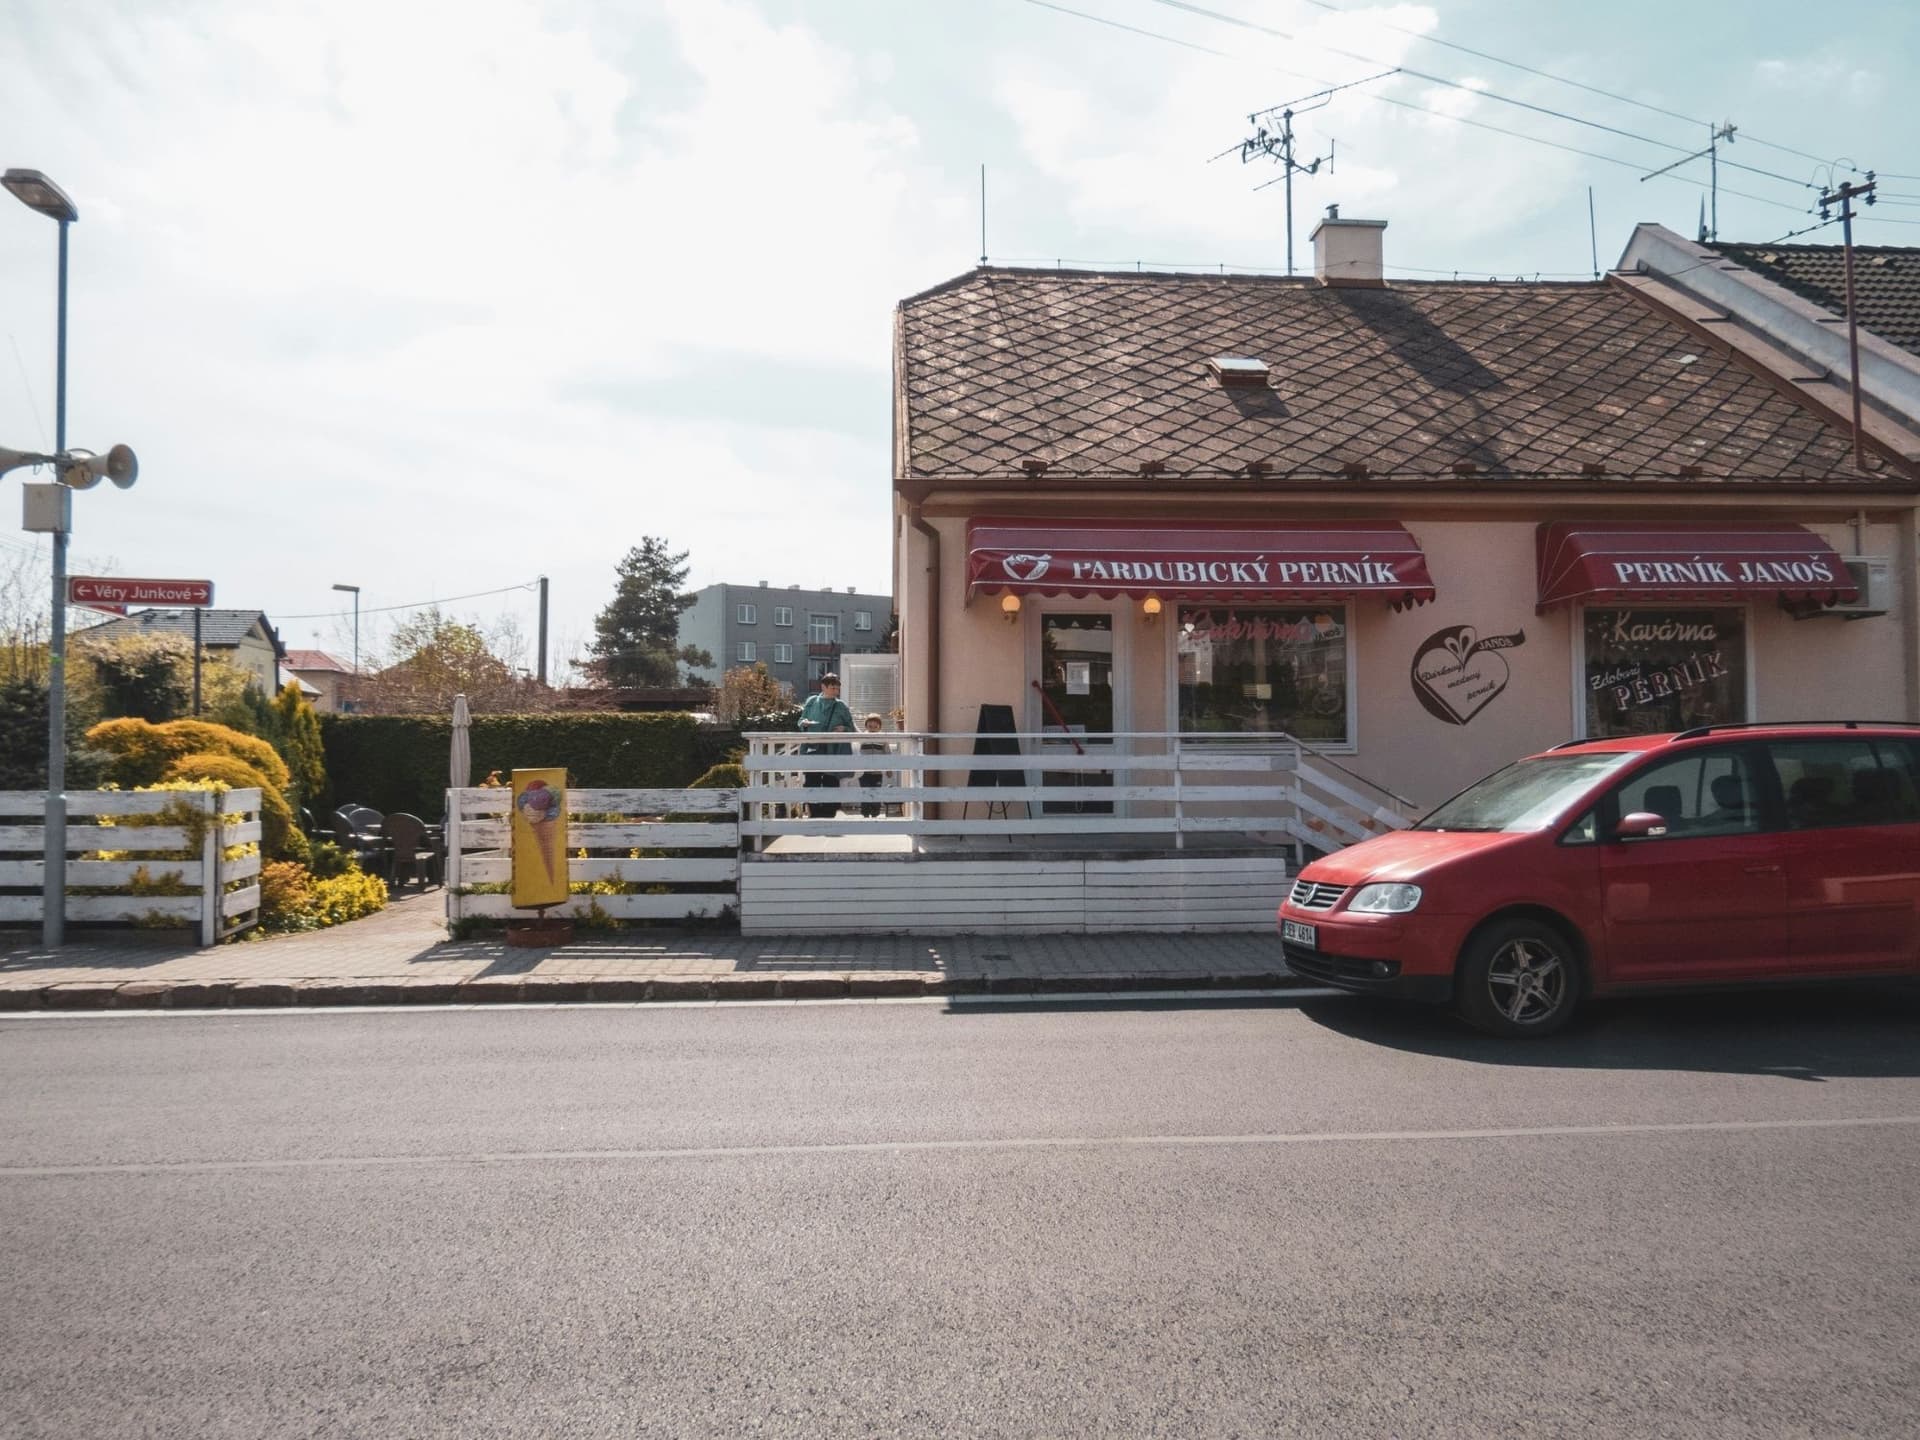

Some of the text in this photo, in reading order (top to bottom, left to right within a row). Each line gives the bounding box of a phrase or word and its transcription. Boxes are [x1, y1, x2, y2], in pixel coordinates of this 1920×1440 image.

[1279, 555, 1400, 584] PERNÍK
[1613, 555, 1834, 583] PERNÍK JANOŠ
[130, 586, 192, 600] Junkové
[1612, 610, 1717, 641] Kavárna
[1612, 651, 1728, 710] PERNÍK
